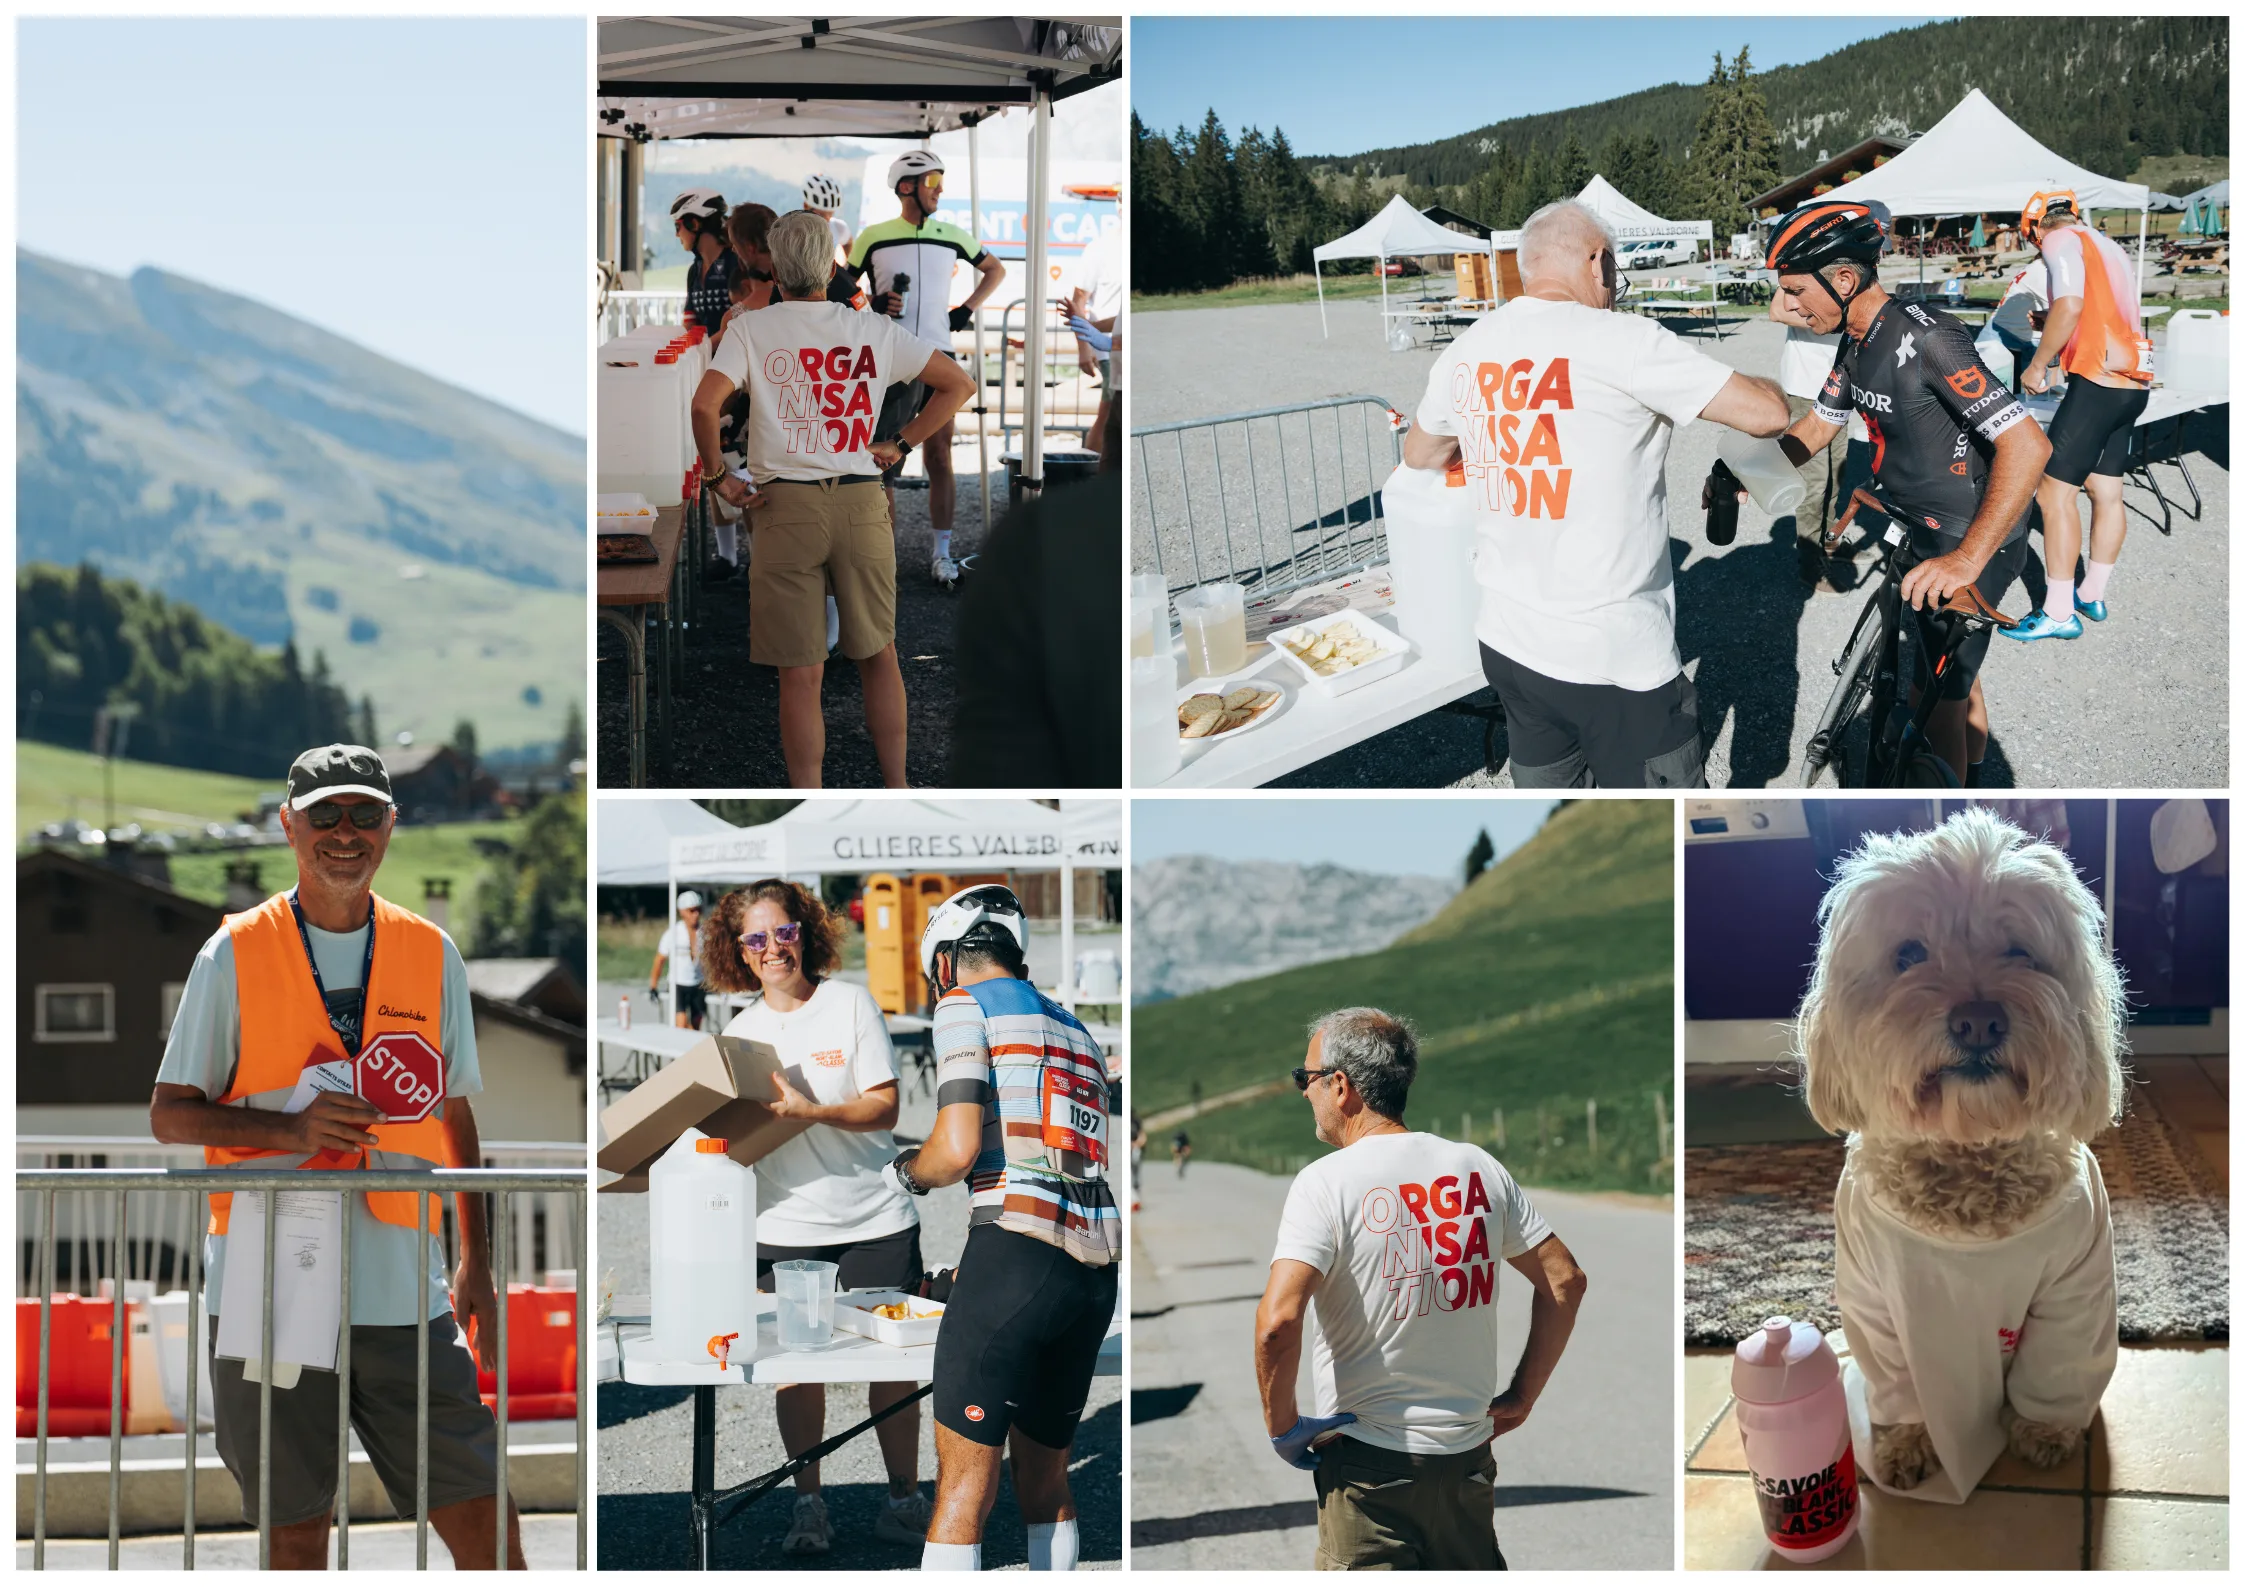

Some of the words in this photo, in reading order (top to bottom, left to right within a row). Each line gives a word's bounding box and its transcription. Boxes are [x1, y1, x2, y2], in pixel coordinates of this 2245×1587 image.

[1948, 280, 1957, 292] P
[1904, 304, 1937, 327] BMC
[1867, 321, 1883, 343] TUDOR
[764, 345, 877, 385] ORGA
[778, 381, 873, 419] NISA
[1452, 357, 1575, 413] ORGA
[1820, 408, 1845, 418] BOSS
[1962, 386, 2008, 418] TUDOR
[1992, 405, 2024, 428] BOSS
[783, 416, 874, 453] TION
[833, 835, 964, 860] GLIERES
[316, 1065, 338, 1082] CONTACTS
[366, 1046, 433, 1104] STOP
[1070, 1105, 1100, 1133] 1197
[1362, 1171, 1492, 1233] ORGA
[1382, 1216, 1490, 1278] NISA
[1388, 1262, 1495, 1321] TION
